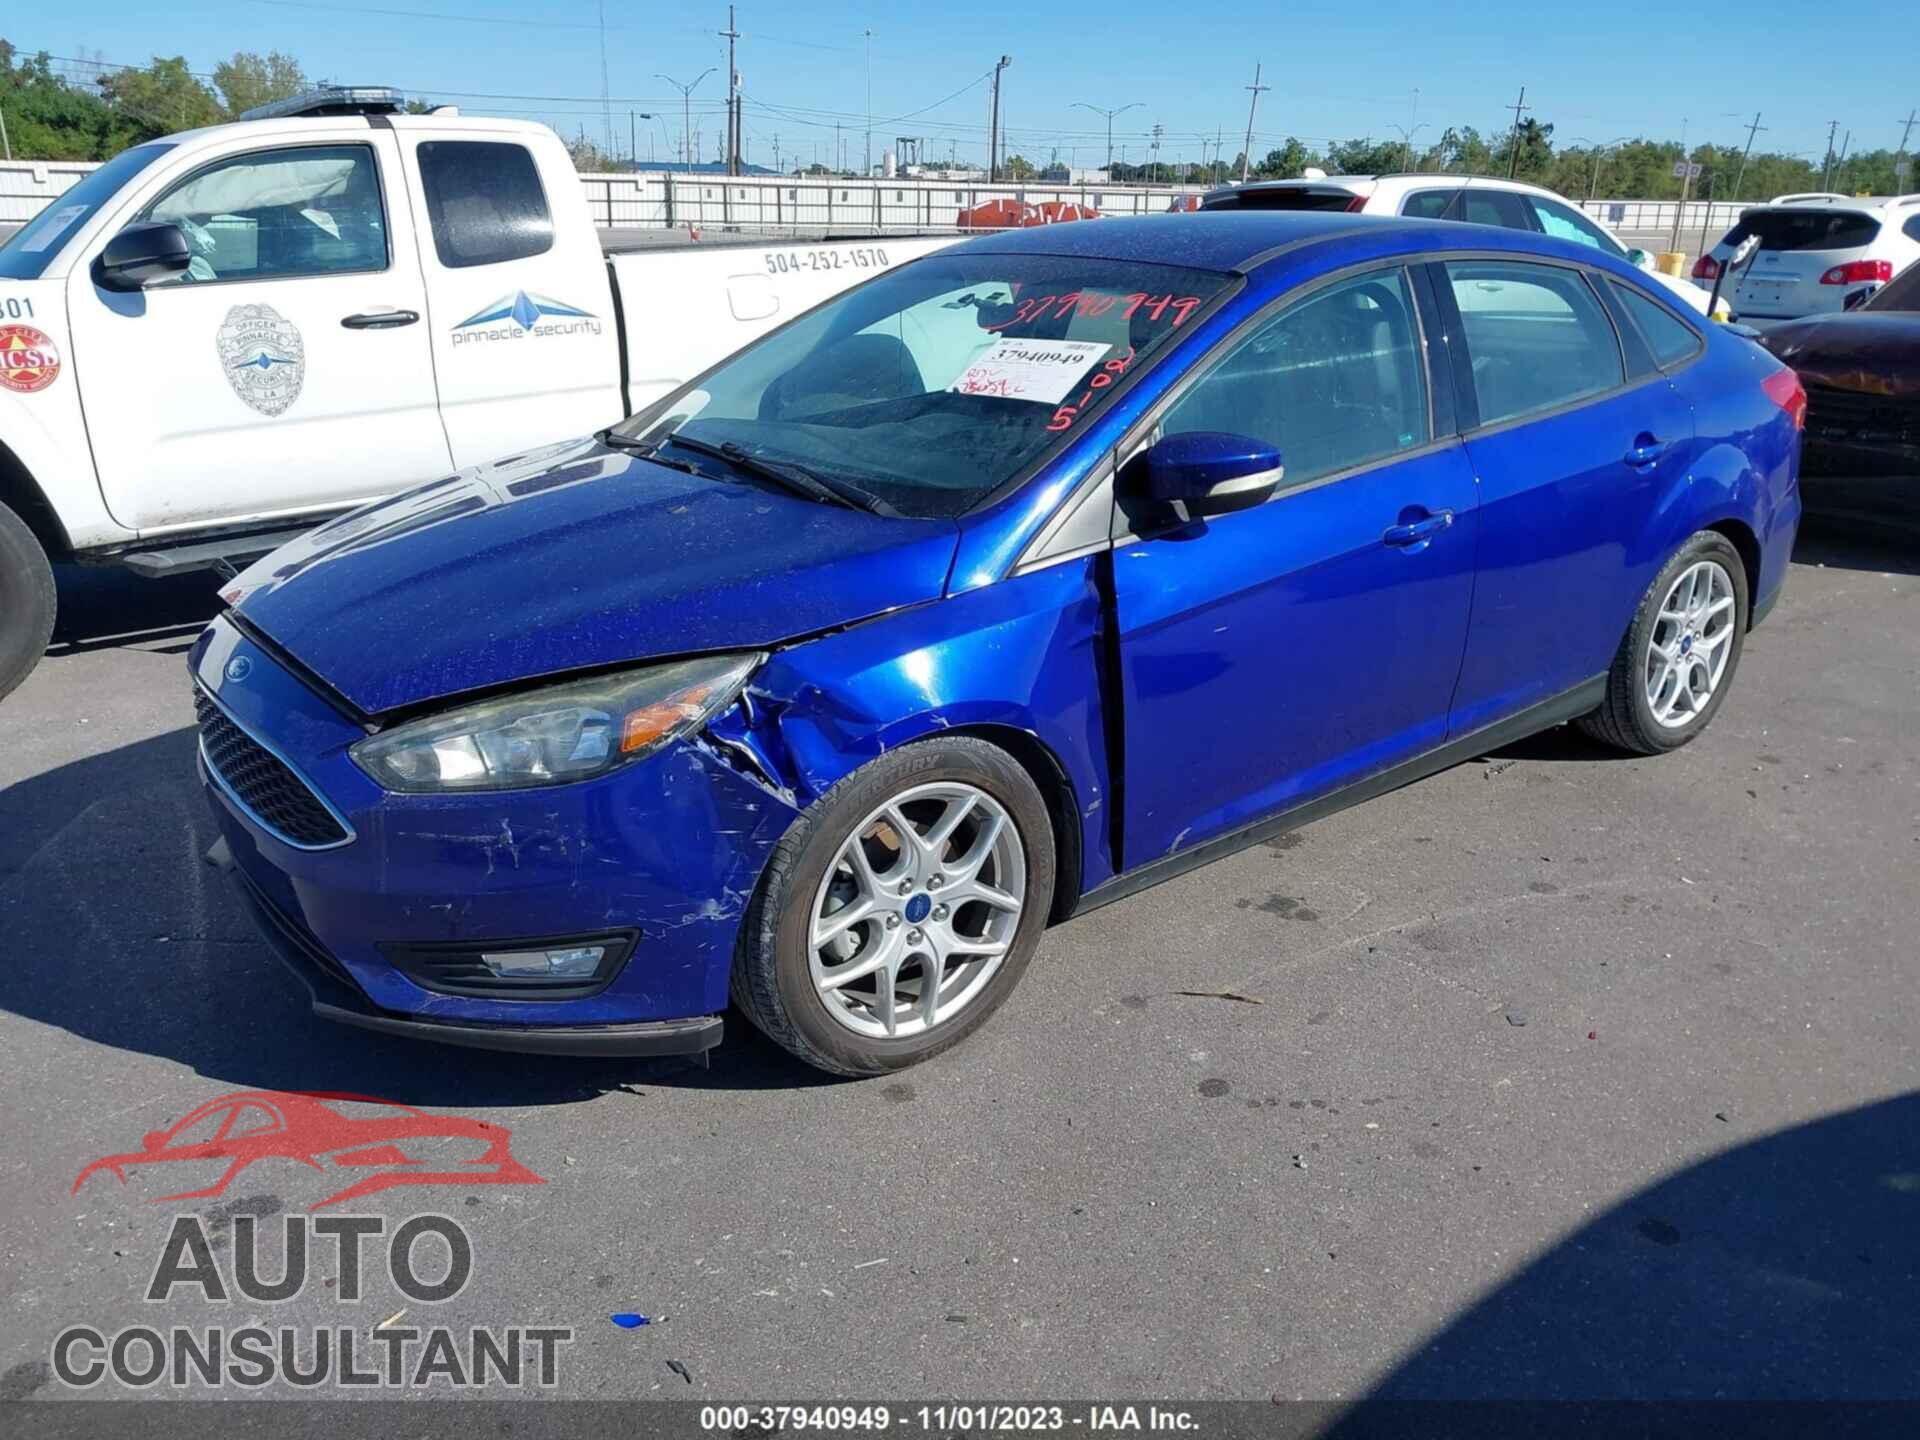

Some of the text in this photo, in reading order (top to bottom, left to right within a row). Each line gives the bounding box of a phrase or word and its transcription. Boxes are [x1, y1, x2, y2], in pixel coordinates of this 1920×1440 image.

[764, 249, 889, 273] 504-252-1570
[236, 321, 276, 332] OFFICER
[452, 319, 601, 347] pinnacle security
[236, 332, 282, 345] PINNACLE
[992, 349, 1085, 365] 37940949
[245, 369, 287, 384] SECURITY
[264, 390, 277, 399] LA
